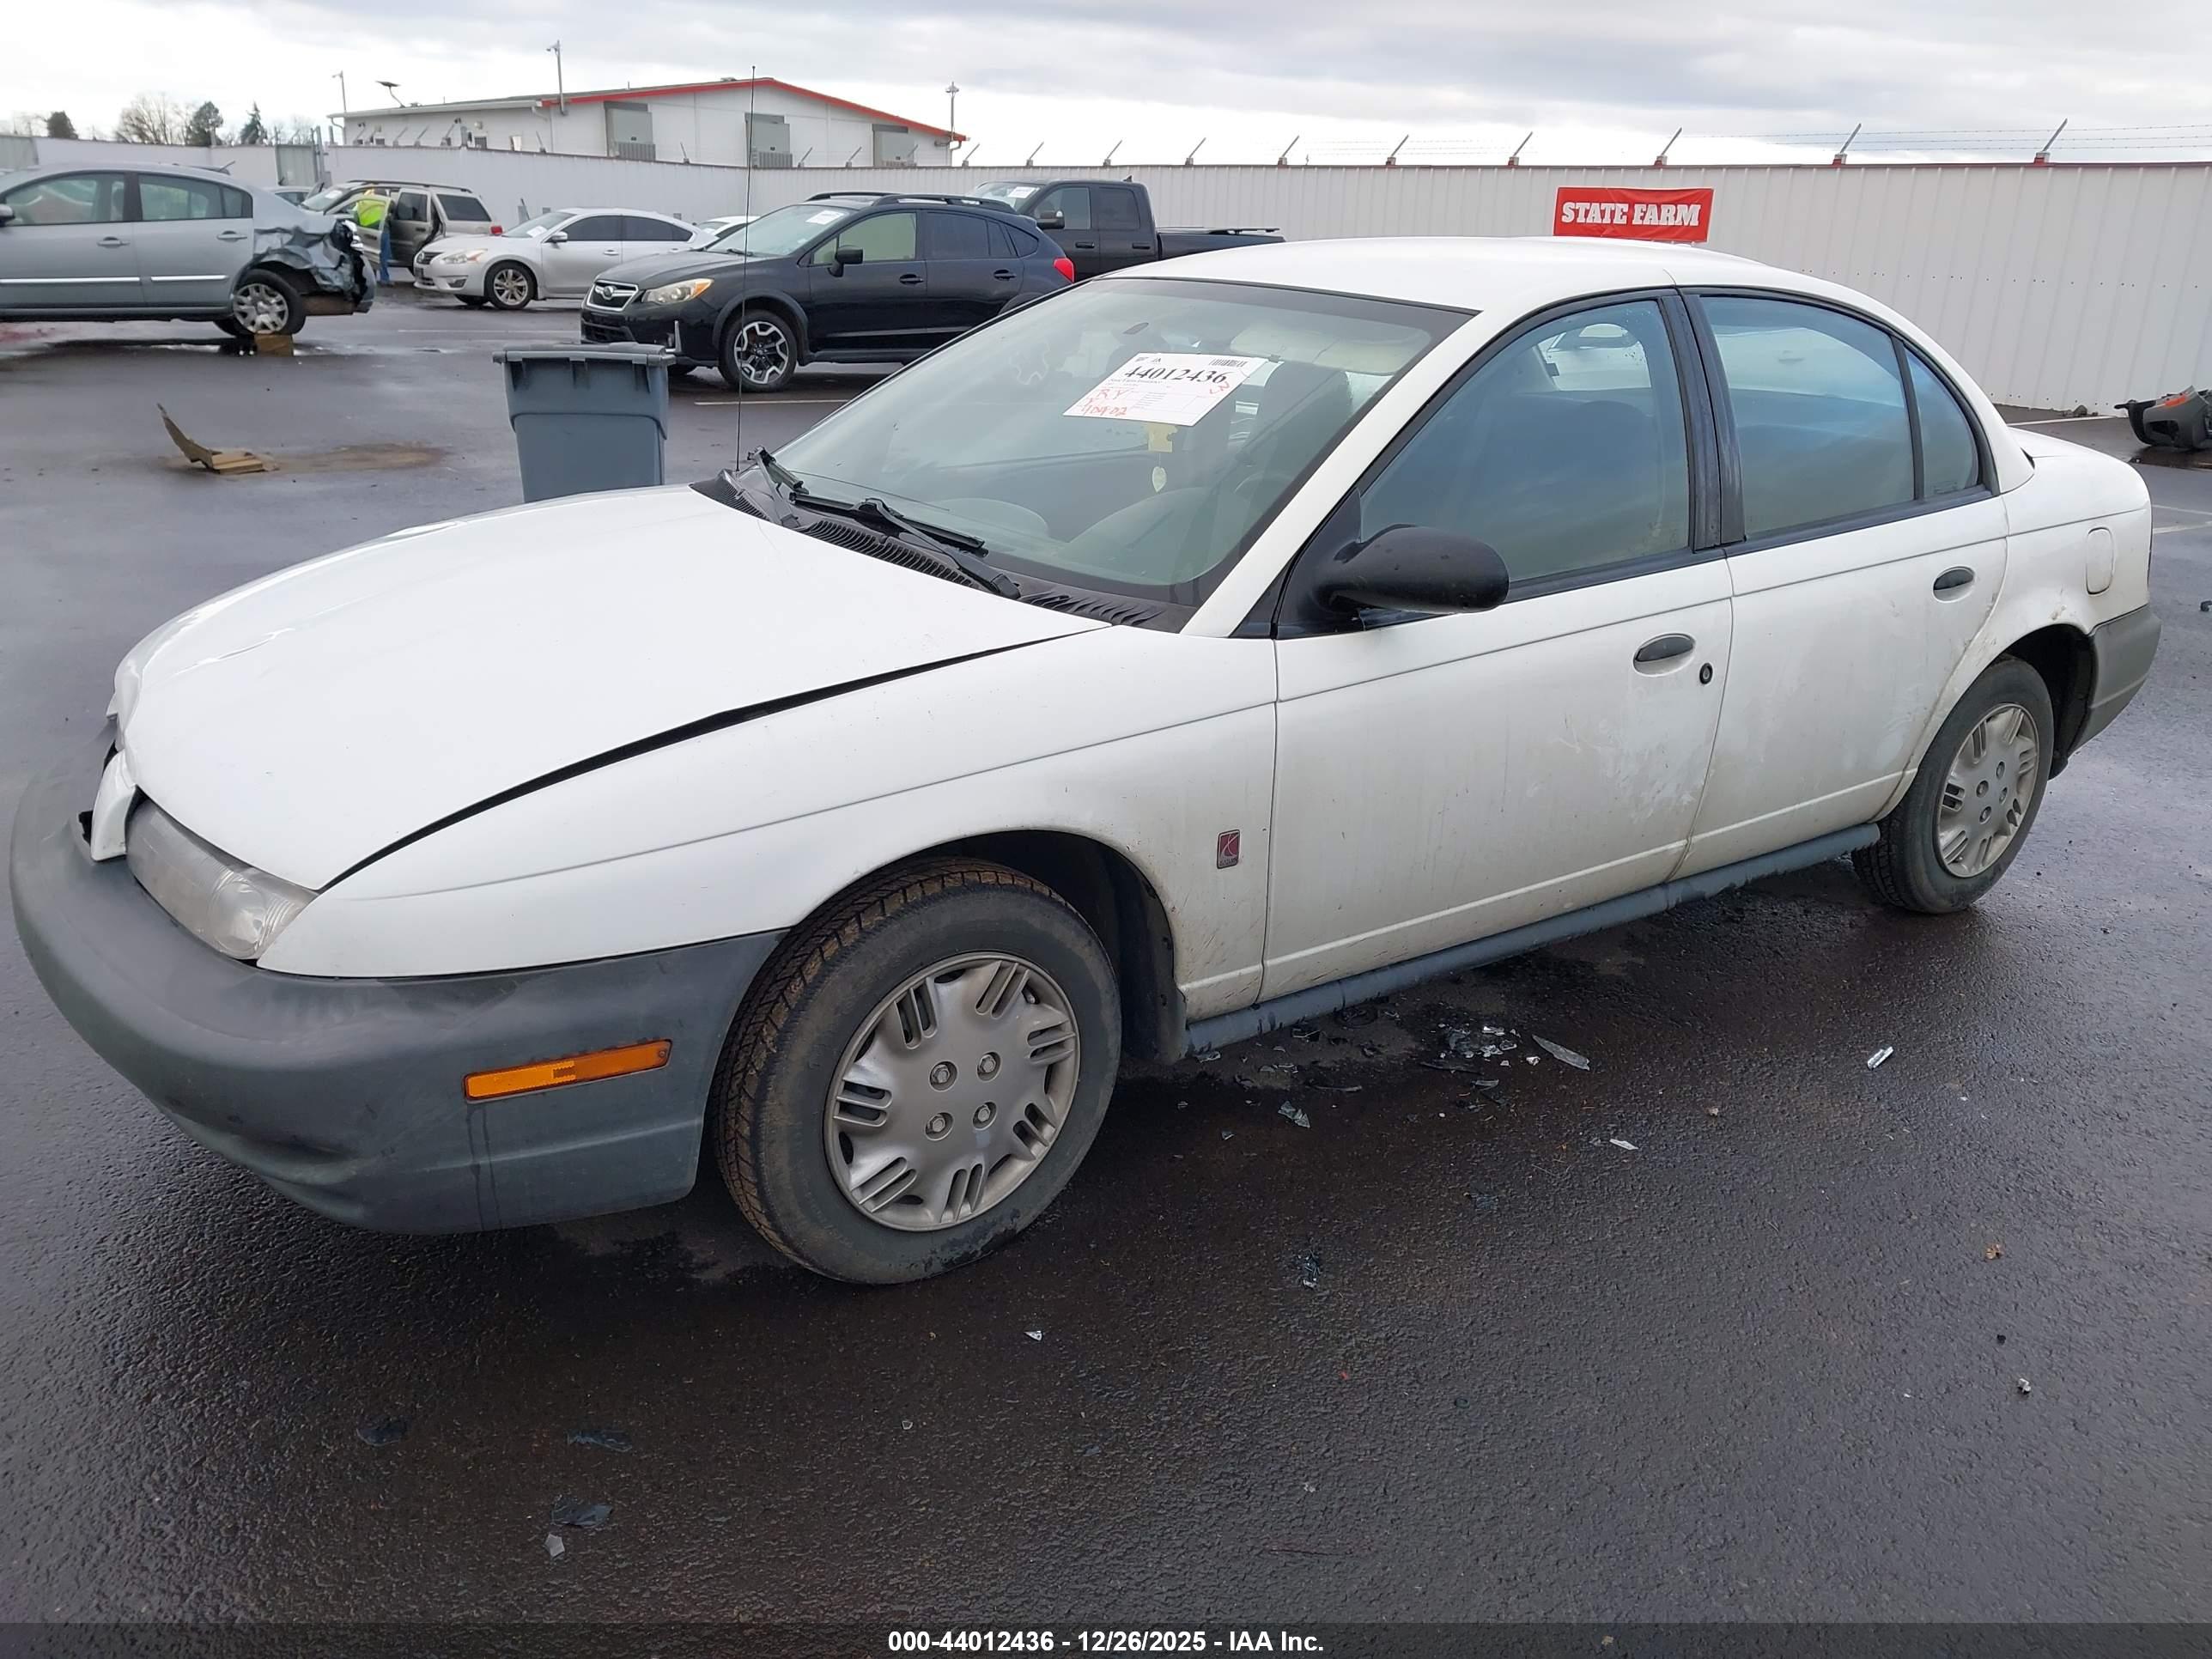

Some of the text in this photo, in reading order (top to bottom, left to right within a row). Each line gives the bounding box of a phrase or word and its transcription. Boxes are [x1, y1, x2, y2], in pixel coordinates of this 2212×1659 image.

[1561, 202, 1701, 227] STATE FARM
[1124, 366, 1228, 384] 44012436
